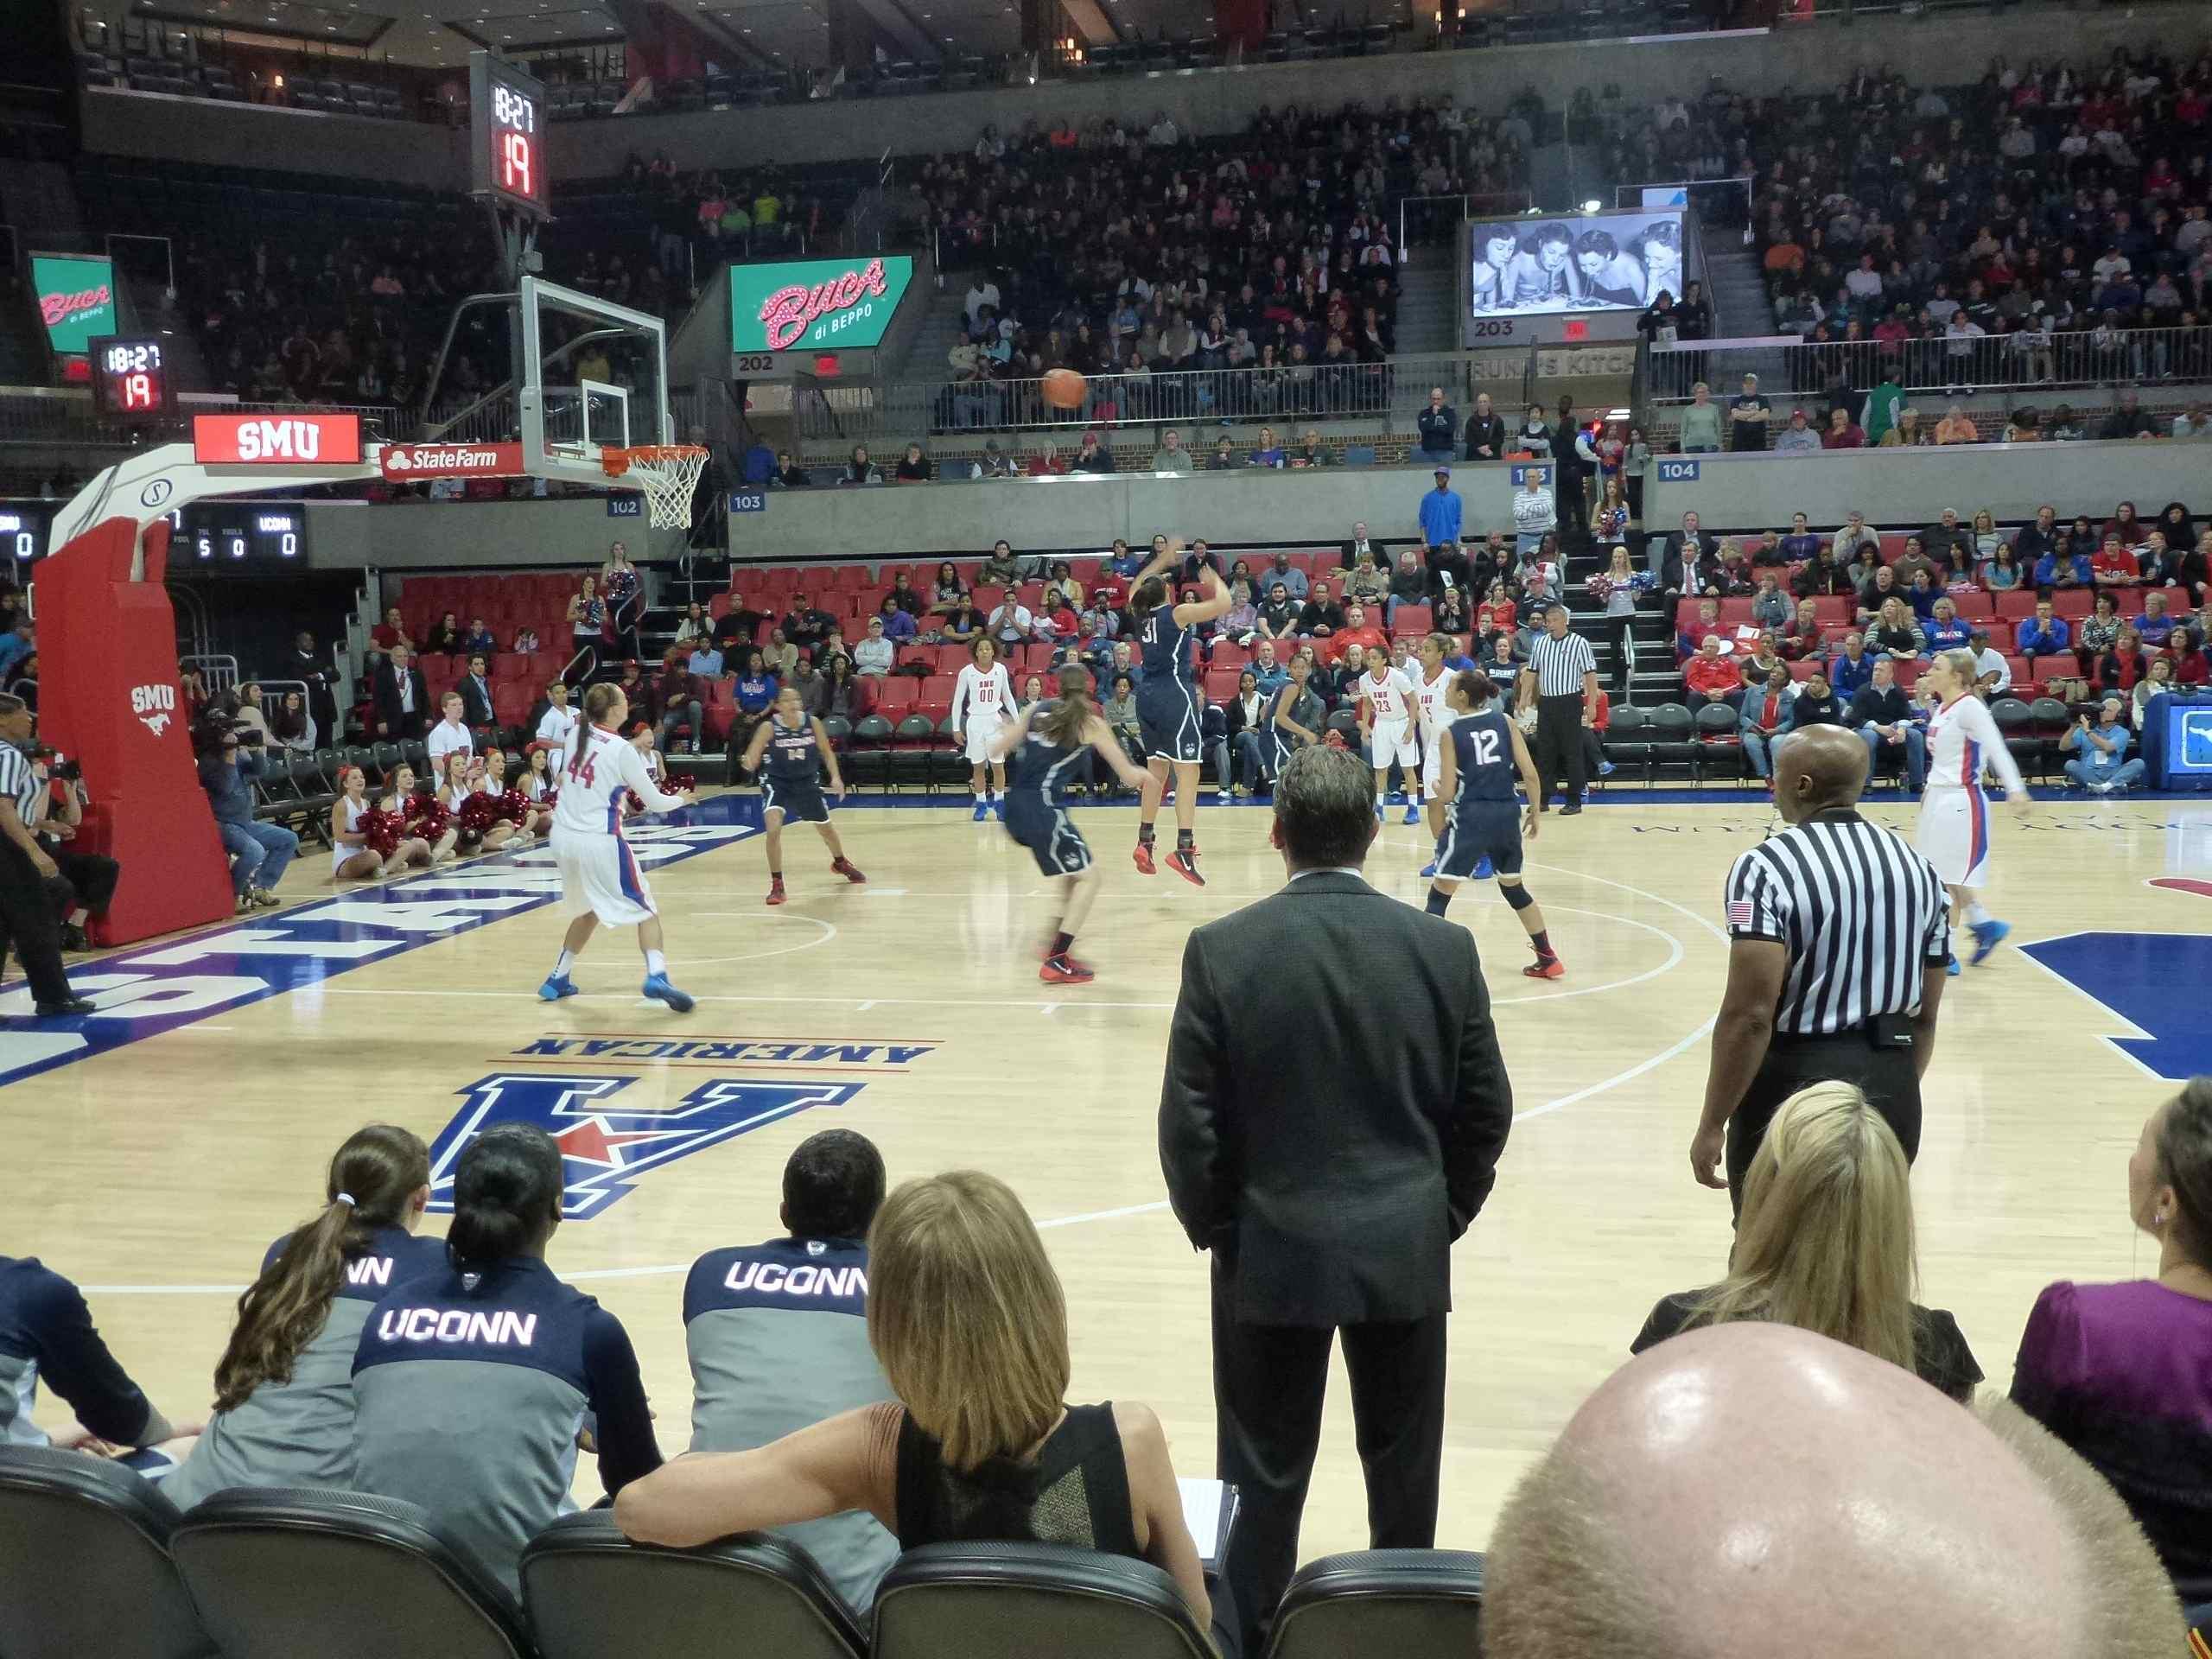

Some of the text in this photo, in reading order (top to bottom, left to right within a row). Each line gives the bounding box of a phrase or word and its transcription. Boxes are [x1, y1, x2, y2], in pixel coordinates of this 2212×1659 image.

[495, 87, 533, 133] 18:27
[505, 133, 530, 194] 19
[816, 302, 873, 340] di BEPPO
[1475, 320, 1513, 337] 203
[108, 346, 160, 372] 18:27
[740, 356, 773, 372] 202
[126, 375, 149, 406] 19
[237, 420, 320, 461] SMU
[1518, 467, 1547, 482] 13
[1662, 463, 1695, 478] 104
[613, 501, 637, 514] 102
[735, 496, 761, 510] 103
[16, 532, 33, 556] 0
[232, 538, 245, 556] 0
[282, 533, 296, 555] 0
[1141, 616, 1158, 644] 31
[131, 684, 175, 714] SMU
[980, 690, 994, 702] 00
[1376, 700, 1392, 713] 23
[1471, 729, 1502, 766] 12
[568, 751, 600, 789] 44
[510, 1038, 938, 1065] AMERICAN
[724, 1261, 869, 1296] UCONN
[378, 1307, 537, 1345] UCONN
